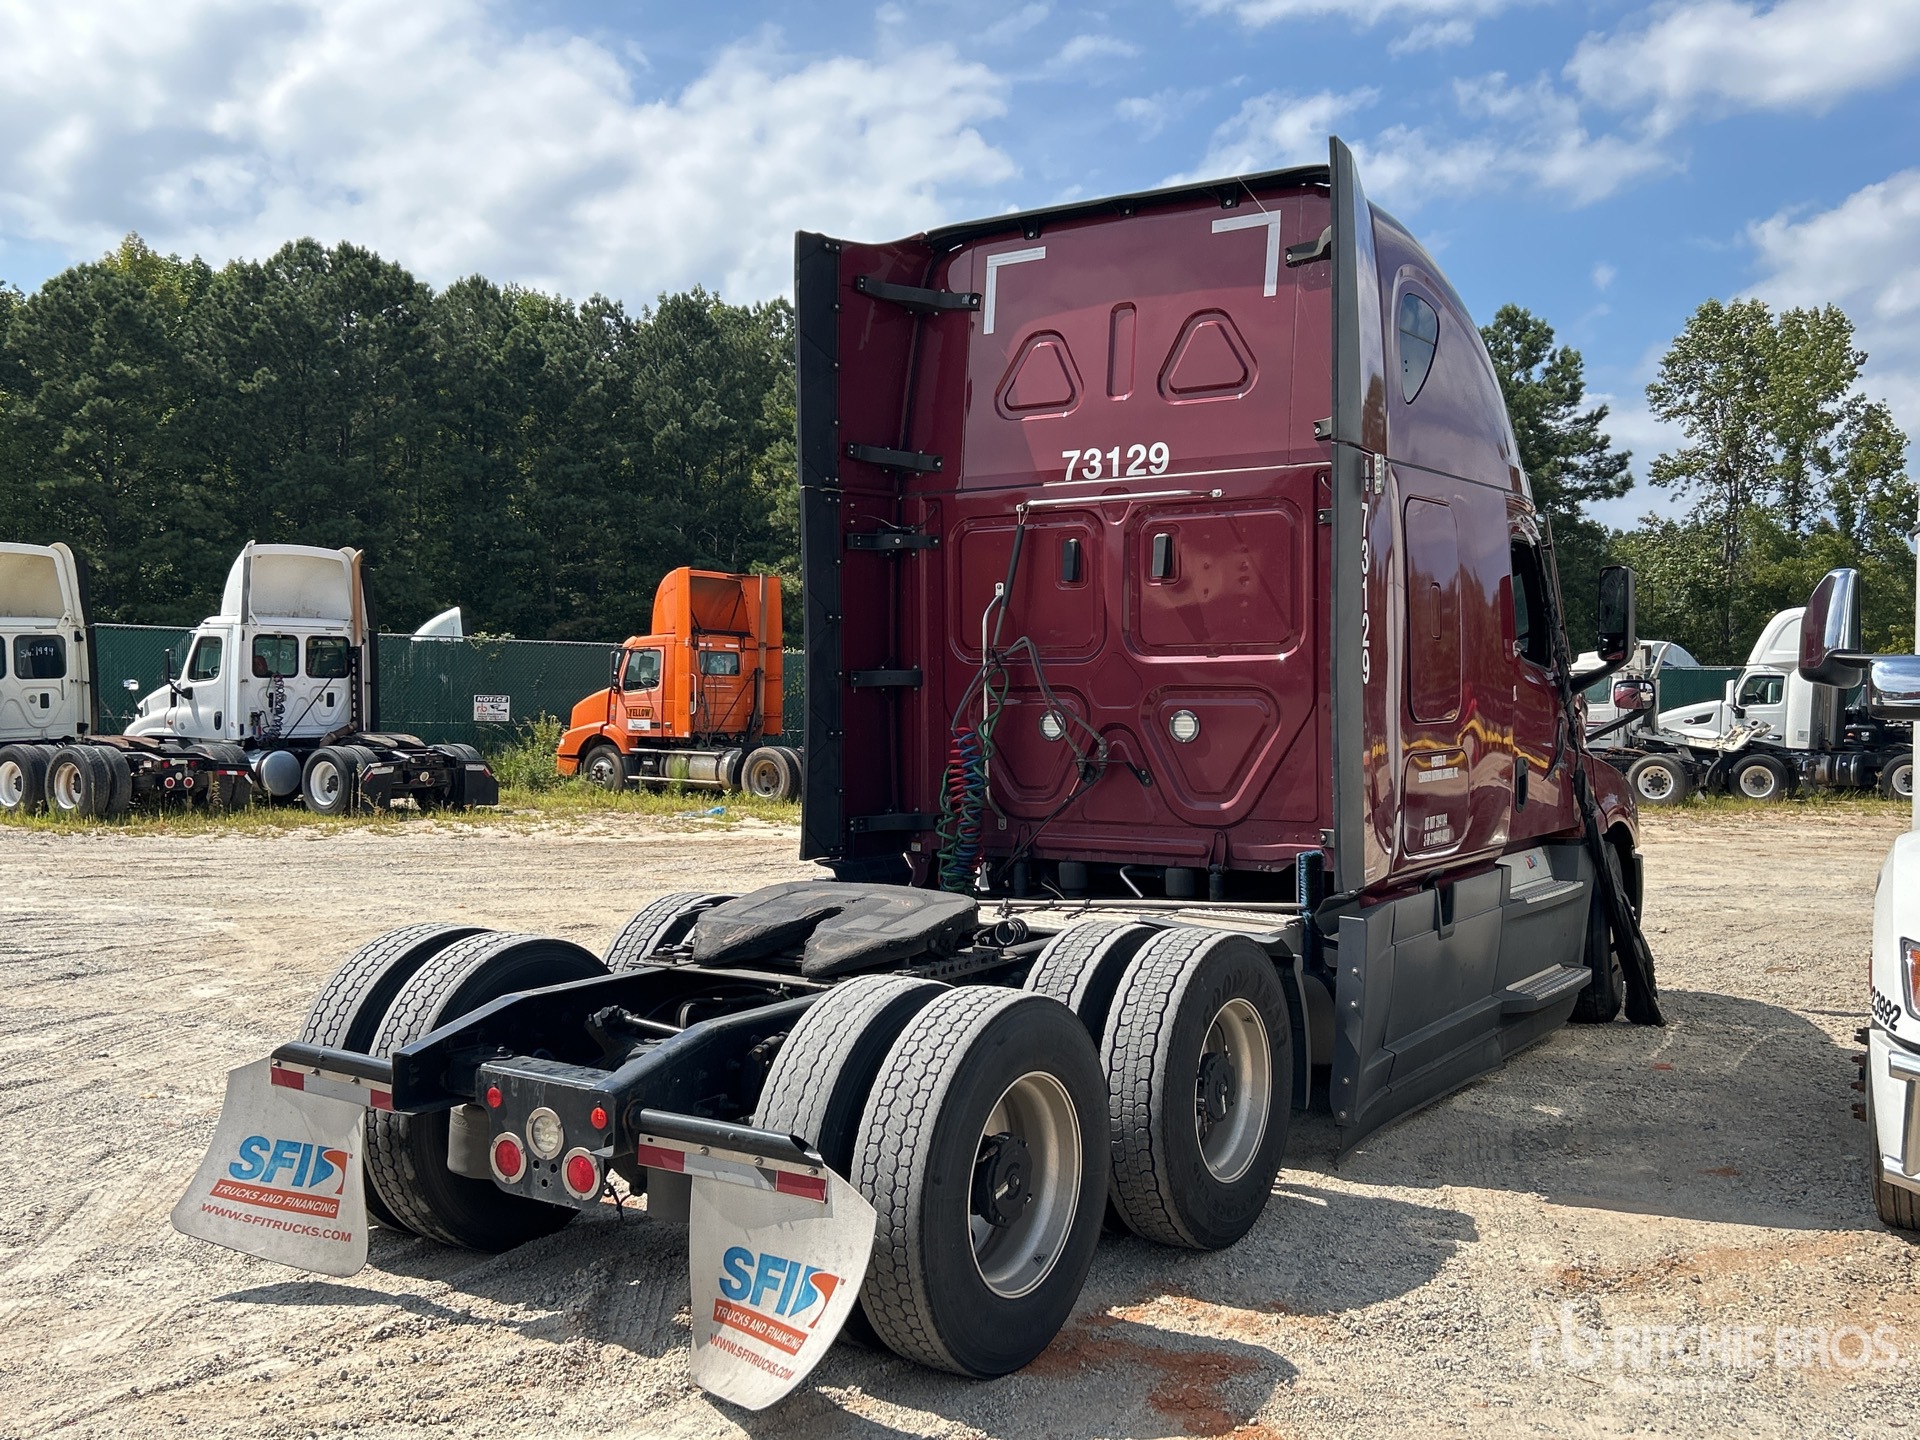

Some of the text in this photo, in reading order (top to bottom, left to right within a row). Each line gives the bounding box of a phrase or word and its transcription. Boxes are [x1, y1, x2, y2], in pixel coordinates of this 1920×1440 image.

[1061, 441, 1170, 482] 73129
[1361, 502, 1371, 685] 73129
[628, 708, 651, 717] YELLOW
[228, 1135, 314, 1188] SFI
[215, 1184, 337, 1214] TRUCKS AND FINANCING
[201, 1203, 352, 1242] WWW.SFITRUCKS.COM
[718, 1246, 802, 1316] SFI
[716, 1305, 803, 1351] TRUCKS AND FINANCING
[710, 1333, 795, 1381] WWW.SFITRUCKS.COM
